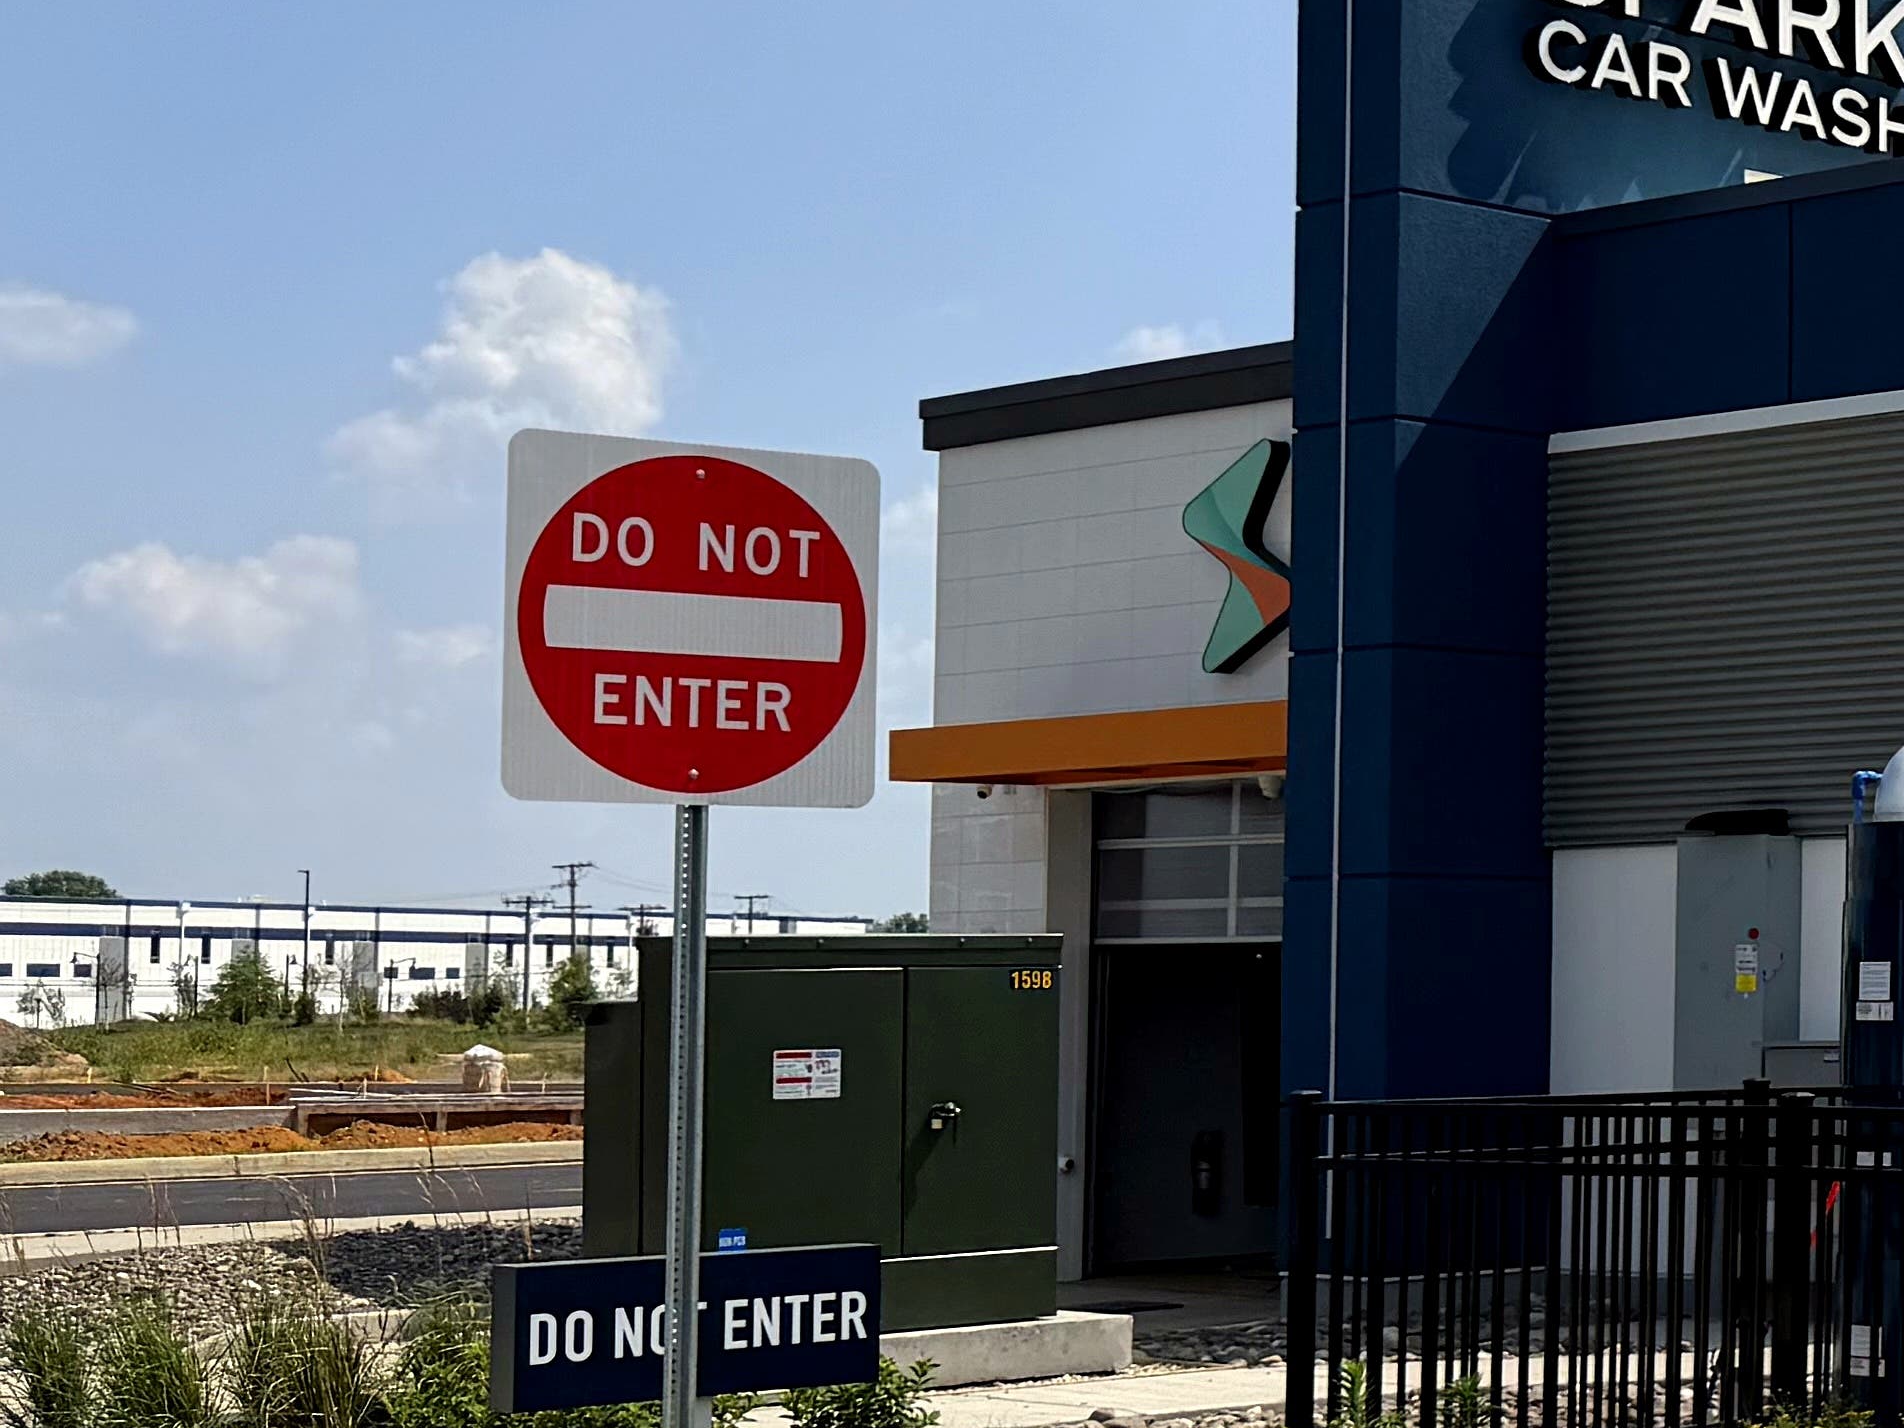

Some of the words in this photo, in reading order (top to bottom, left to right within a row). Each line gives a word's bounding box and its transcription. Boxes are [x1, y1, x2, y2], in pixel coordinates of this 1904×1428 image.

[1538, 19, 1693, 108] CAR
[572, 512, 655, 567] DO
[699, 522, 820, 578] NOT
[594, 673, 792, 732] ENTER
[1011, 970, 1052, 989] 1598
[529, 1310, 594, 1366] DO
[723, 1291, 868, 1351] ENTER
